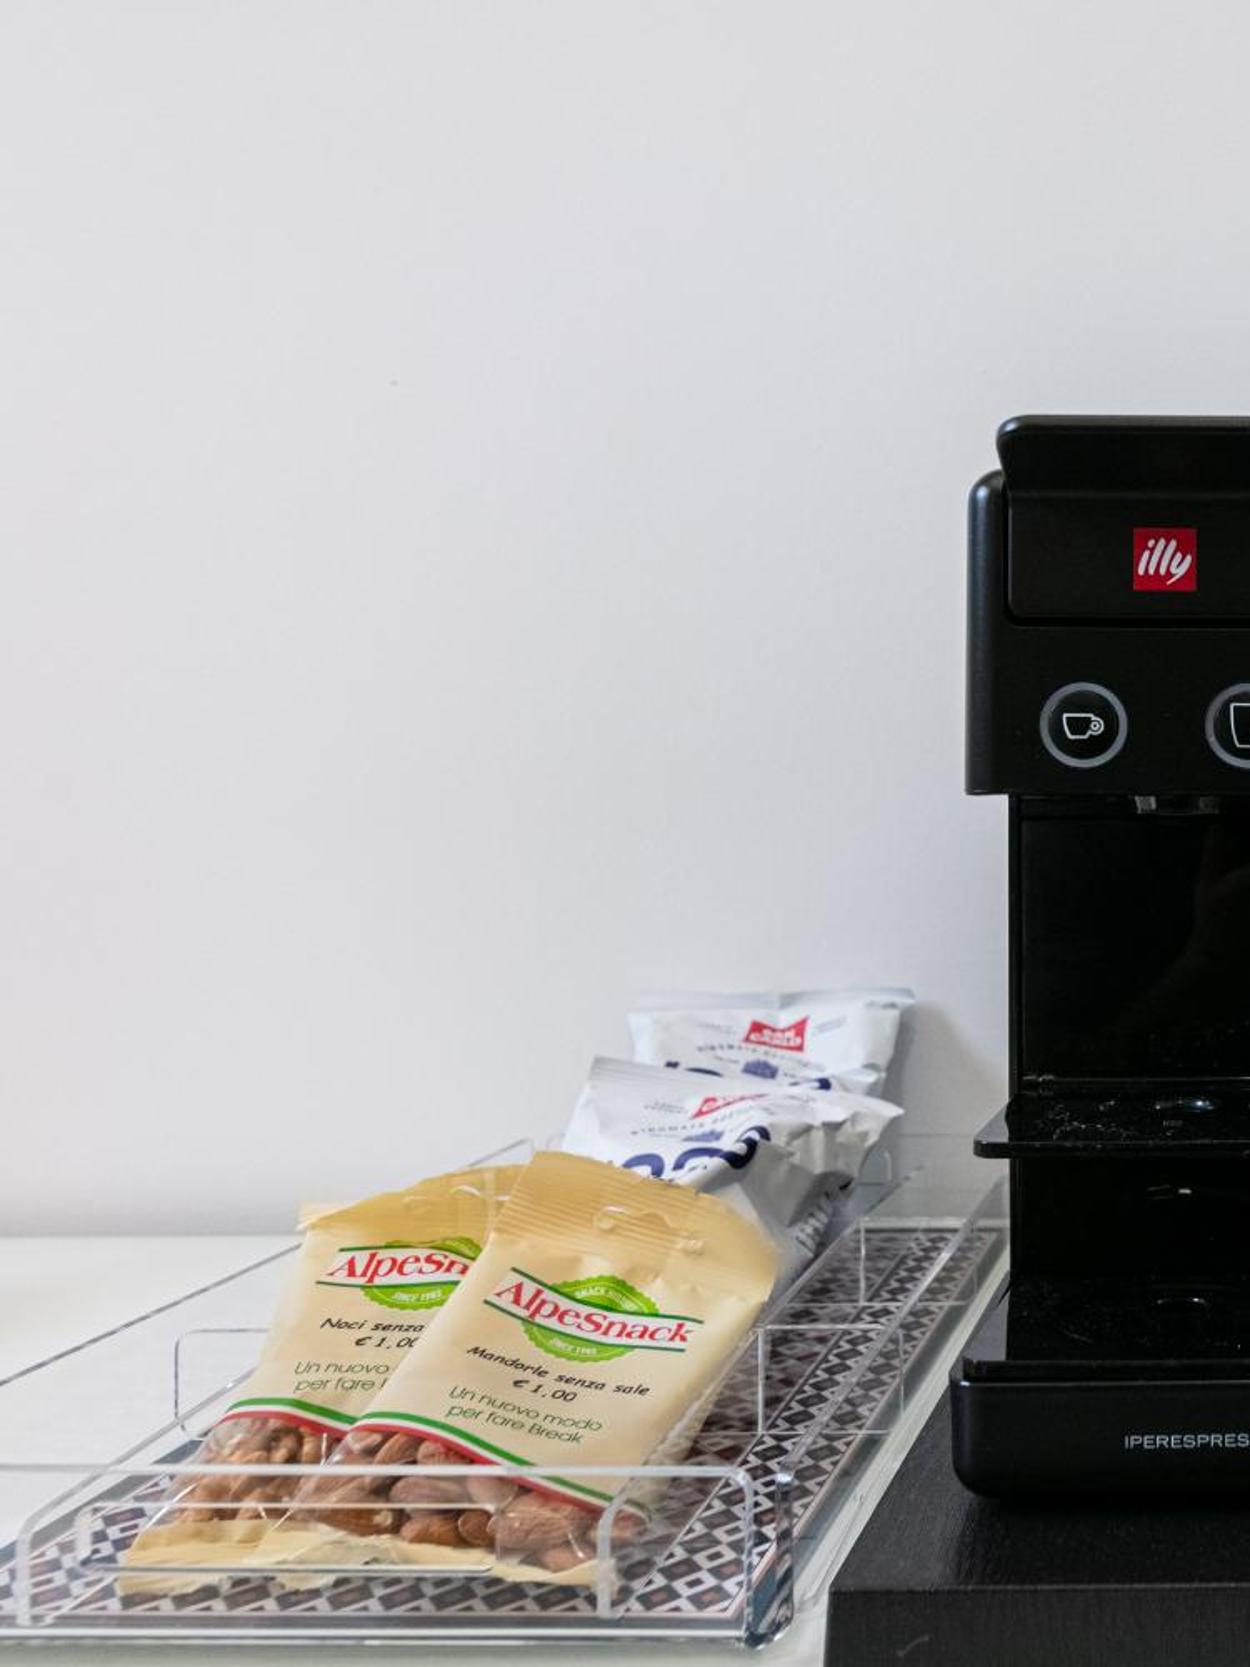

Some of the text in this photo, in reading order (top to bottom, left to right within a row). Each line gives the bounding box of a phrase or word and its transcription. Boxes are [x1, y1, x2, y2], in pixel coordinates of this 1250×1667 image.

[1138, 537, 1192, 585] illy
[320, 1318, 425, 1333] Noci senza
[494, 1280, 692, 1343] AlpeSnack
[293, 1361, 390, 1375] Un nuovo
[293, 1379, 332, 1394] per
[334, 1377, 376, 1392] fare
[466, 1346, 651, 1397] Mandorle senza sale
[445, 1404, 585, 1444] per fare Break
[448, 1385, 603, 1432] Un nuovo modo
